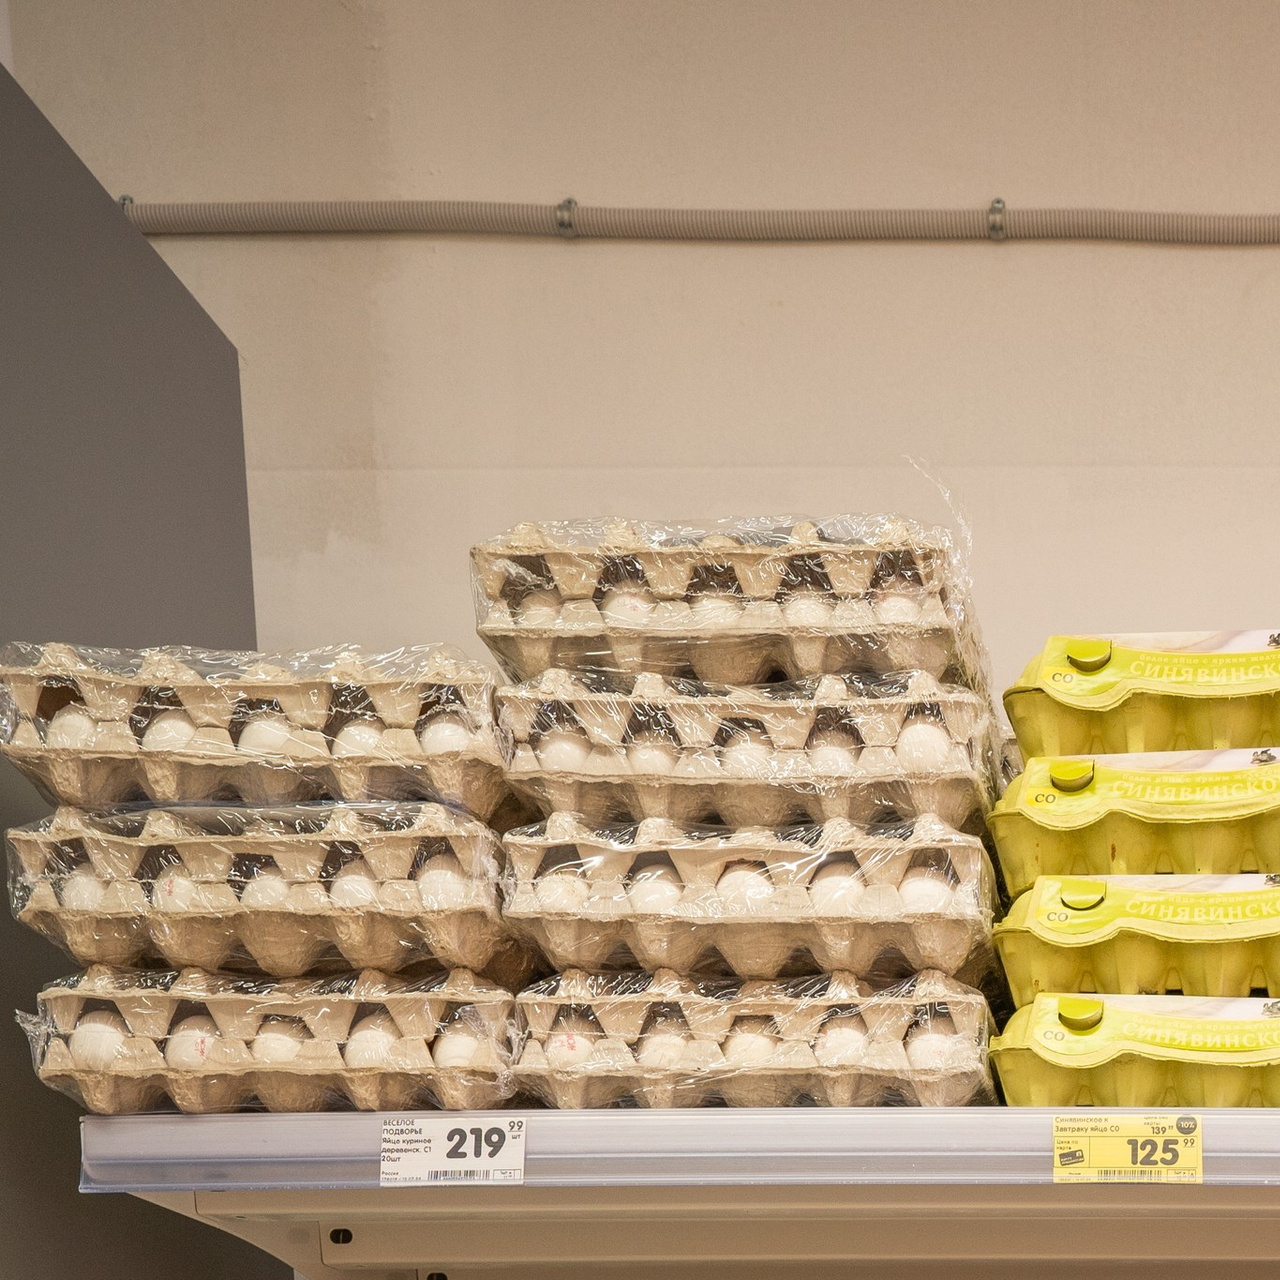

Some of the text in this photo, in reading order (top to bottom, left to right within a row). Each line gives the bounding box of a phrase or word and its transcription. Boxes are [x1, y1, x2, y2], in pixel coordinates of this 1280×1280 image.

[508, 1120, 524, 1131] 99
[1151, 1126, 1166, 1135] 139
[446, 1127, 506, 1159] 219
[1126, 1139, 1179, 1166] 125
